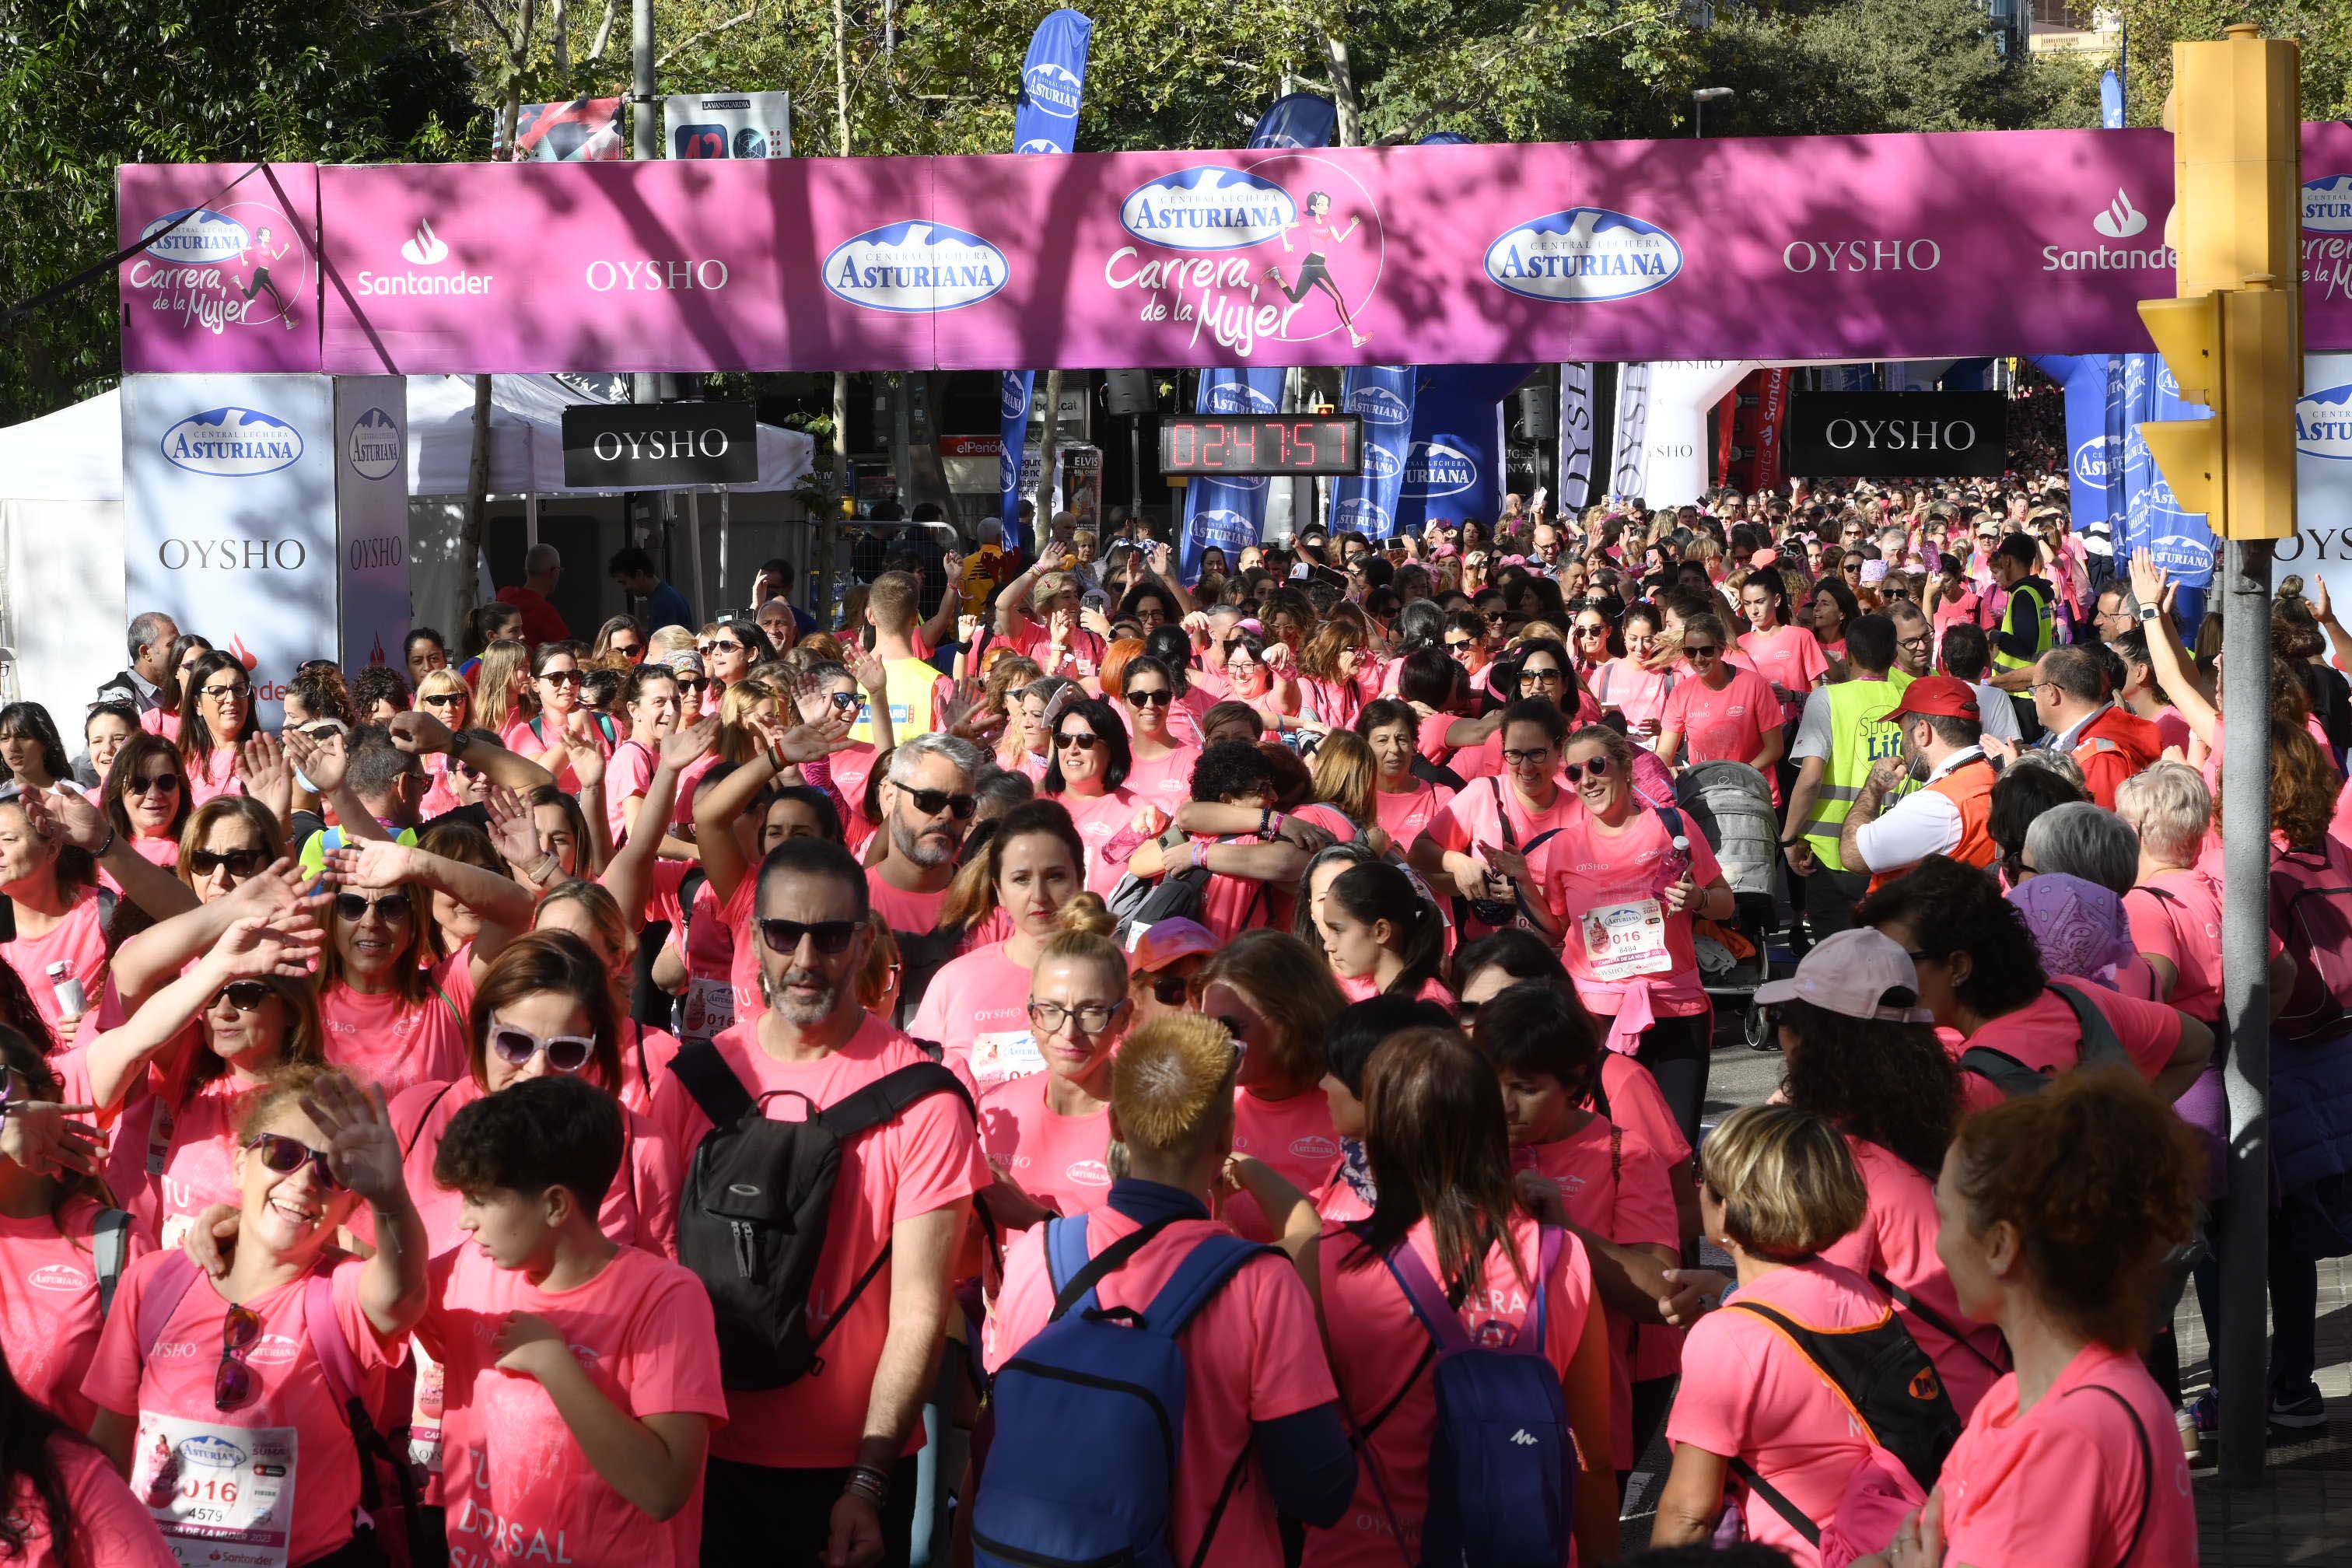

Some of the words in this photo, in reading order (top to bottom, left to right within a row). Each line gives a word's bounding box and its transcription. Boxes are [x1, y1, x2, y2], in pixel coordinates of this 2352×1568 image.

[1160, 194, 1214, 204] CENTRAL
[1221, 194, 1278, 203] LECHERA
[1133, 198, 1283, 229] ASTURIANA
[2302, 203, 2352, 218] STUR
[147, 229, 242, 250] ASTURIANA
[1530, 241, 1591, 251] CENTRAL
[865, 251, 926, 261] CENTRAL
[929, 250, 989, 261] LECHERA
[1500, 244, 1667, 279] ASTURIANA
[1783, 239, 1941, 273] OYSHO
[2042, 244, 2178, 271] Santande
[130, 260, 222, 289] Carrera
[586, 258, 729, 291] OYSHO
[837, 255, 996, 290] ASTURIANA
[1104, 247, 1251, 289] Carrera
[2315, 261, 2329, 282] la
[358, 270, 492, 296] Santander
[152, 289, 170, 310] de
[173, 290, 186, 310] la
[183, 286, 256, 335] Mujer
[1140, 291, 1168, 322] de
[1174, 291, 1193, 321] la
[1188, 284, 1305, 358] Mujer
[1349, 397, 1403, 421] ASTURIANA
[193, 430, 236, 439] CENTRAL
[243, 430, 289, 439] LECHERA
[593, 428, 729, 462] OYSHO
[1173, 423, 1346, 467] 02:47:57
[1825, 418, 1976, 452] OYSHO
[172, 432, 294, 460] ASTURIANA
[352, 435, 397, 464] ASTURIANA
[1505, 449, 1535, 460] UGES
[1074, 457, 1099, 467] ELVIS
[1363, 459, 1394, 474] RIANA
[1506, 463, 1535, 474] NYA
[1337, 513, 1384, 530] STURIANA
[1192, 520, 1254, 547] ASTURIANA
[158, 538, 306, 571] OYSHO
[350, 534, 402, 571] OYSHO
[1867, 731, 1902, 762] Lif
[1576, 863, 1609, 872] OYSHO
[1608, 915, 1640, 925] ASTURIANA
[1612, 931, 1641, 945] 016
[706, 1013, 735, 1027] 016
[975, 1007, 1021, 1021] OYSHO
[1293, 1143, 1333, 1153] ASTURIANA
[162, 1174, 190, 1208] TU
[33, 1272, 83, 1288] ASTURIANA
[149, 1342, 197, 1358] YSHO
[183, 1444, 243, 1463] ASTURIANA
[182, 1480, 238, 1503] 016
[187, 1507, 223, 1522] 4579
[186, 1526, 201, 1536] DE
[201, 1528, 214, 1538] LA
[215, 1530, 248, 1540] MUJER
[457, 1497, 573, 1565] DORSAL
[222, 1552, 274, 1566] Santander
